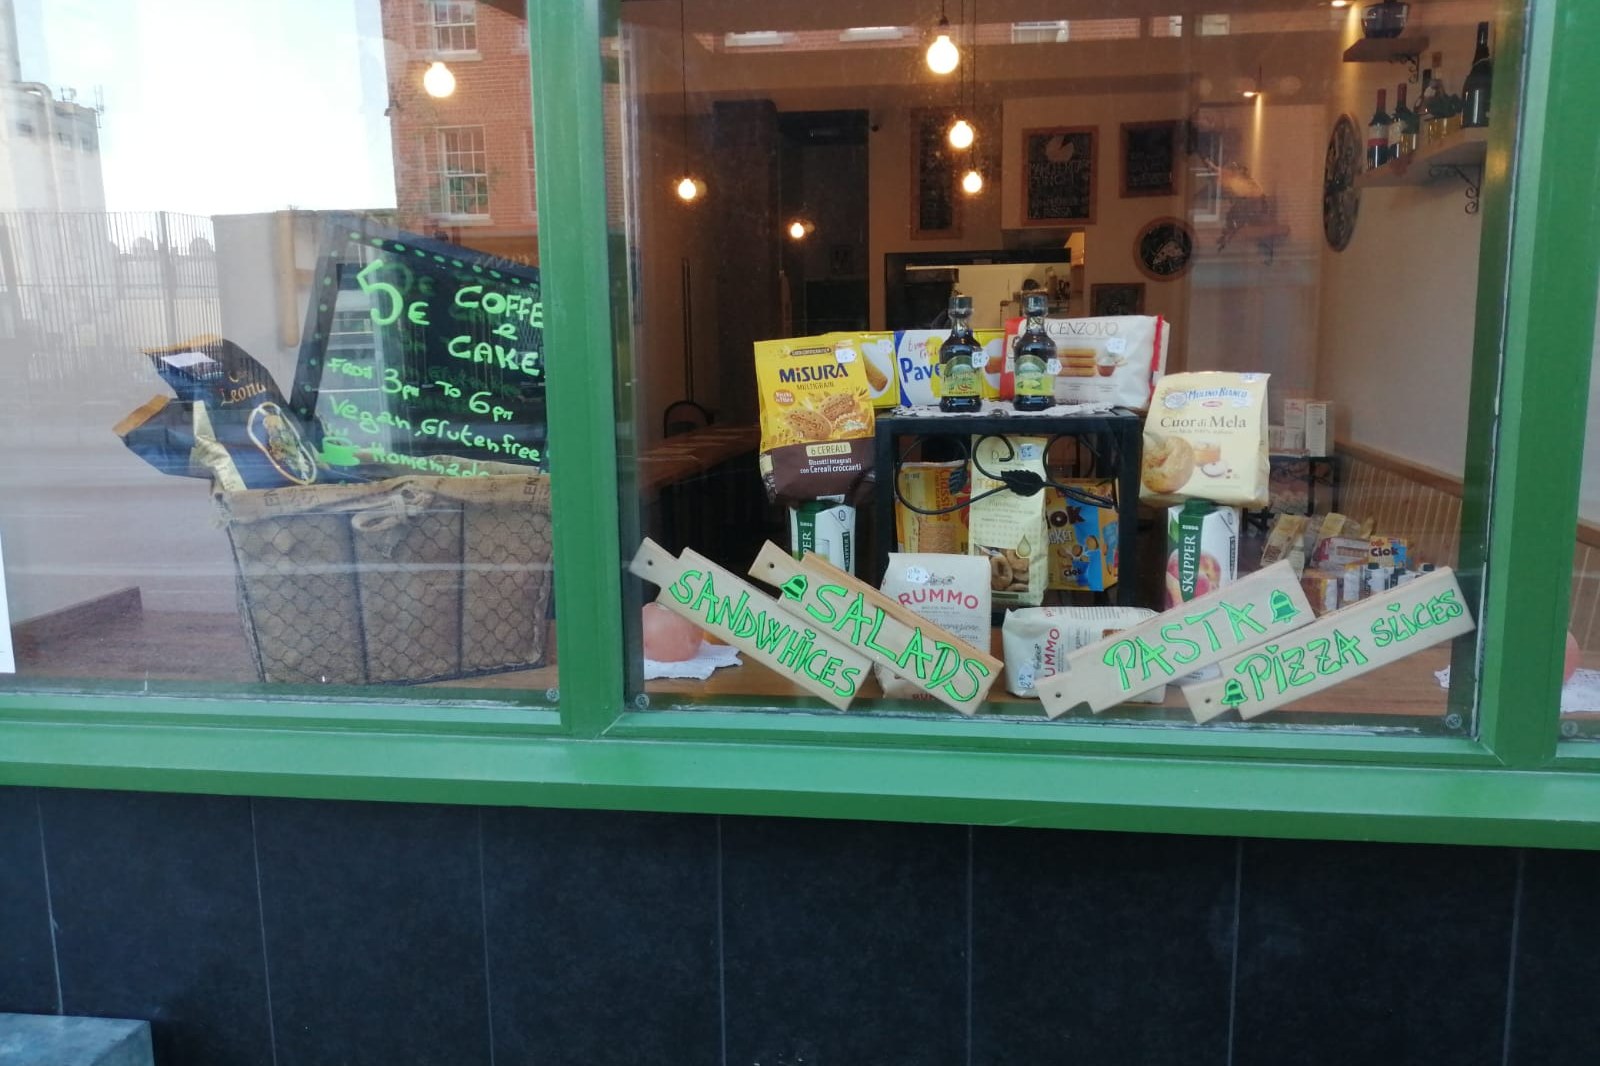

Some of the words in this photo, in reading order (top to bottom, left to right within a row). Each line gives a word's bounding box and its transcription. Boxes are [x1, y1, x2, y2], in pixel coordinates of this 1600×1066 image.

[448, 335, 541, 377] CAKE
[1160, 415, 1196, 429] Cuor
[1208, 414, 1248, 429] Mela
[817, 443, 848, 455] CEREALI
[810, 464, 832, 474] Cereali
[832, 463, 862, 473] croccanti
[1181, 534, 1197, 594] SKIPPER
[897, 588, 980, 611] RUMMO
[805, 583, 990, 702] SALADS
[1102, 600, 1268, 691] PASTA
